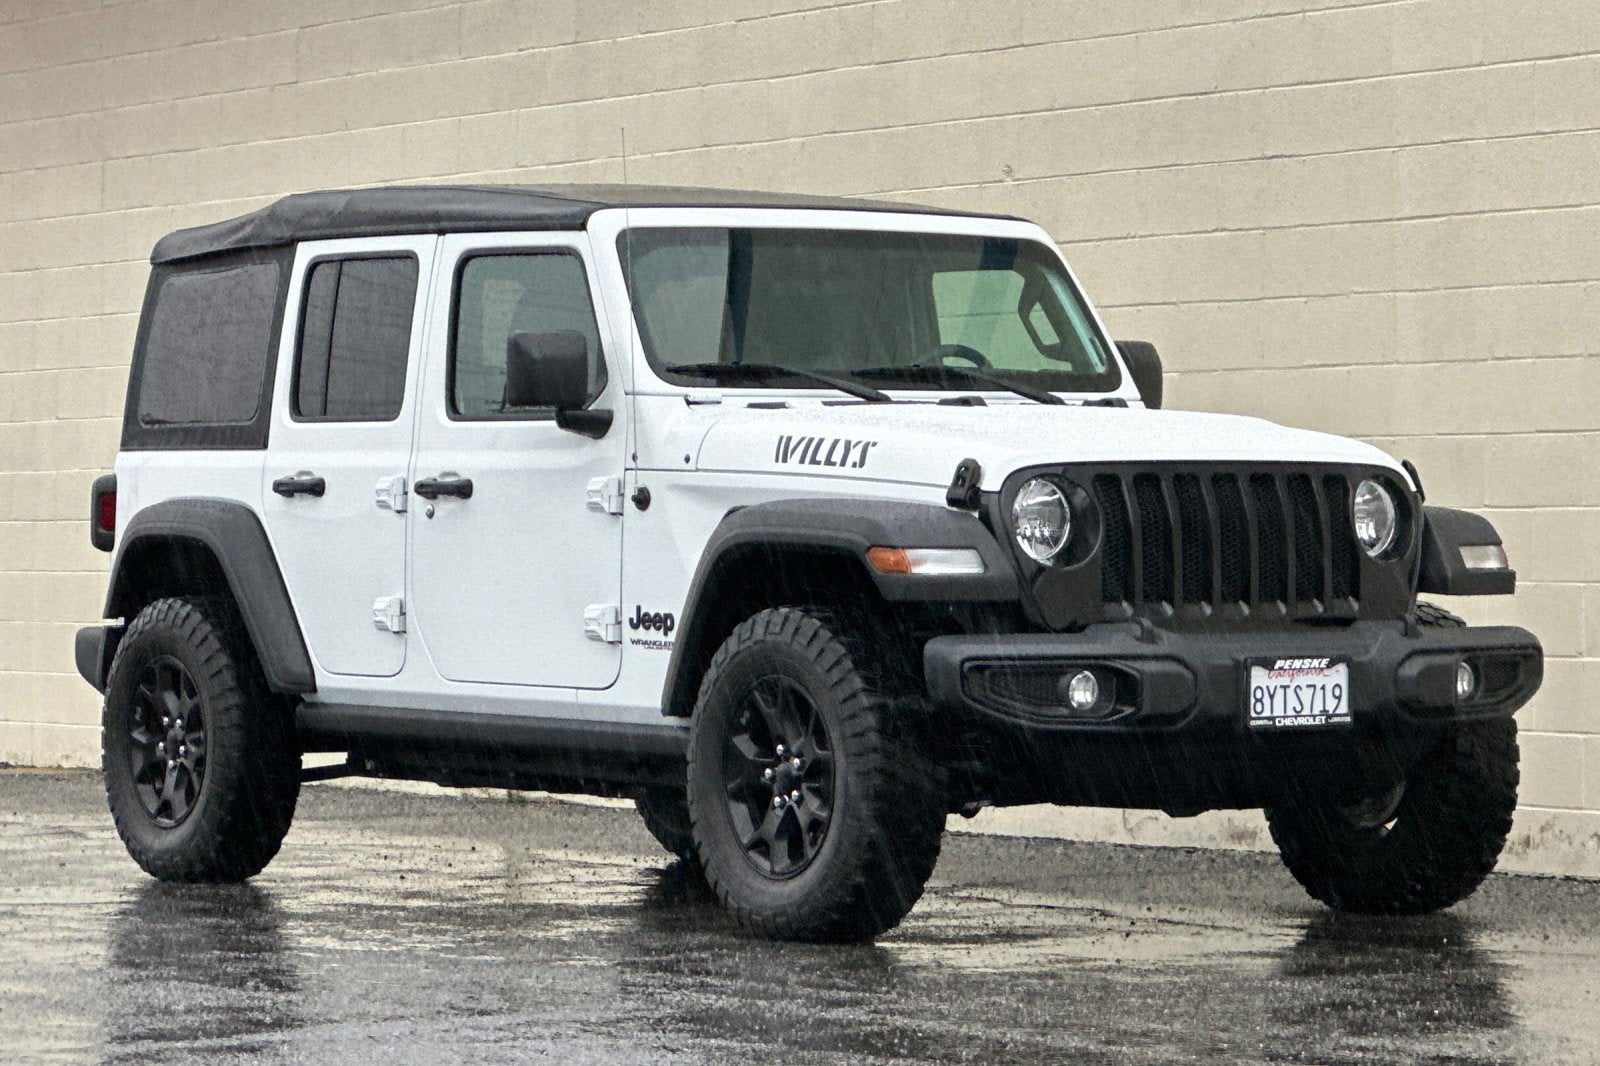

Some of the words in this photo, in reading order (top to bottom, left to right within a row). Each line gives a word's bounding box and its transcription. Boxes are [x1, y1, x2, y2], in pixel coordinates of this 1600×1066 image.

[775, 435, 878, 469] WILLYS
[629, 604, 675, 637] Jeep
[1274, 658, 1331, 670] PENSKE
[1253, 683, 1343, 716] 8YTS719
[1275, 716, 1327, 727] CHEVROLET
